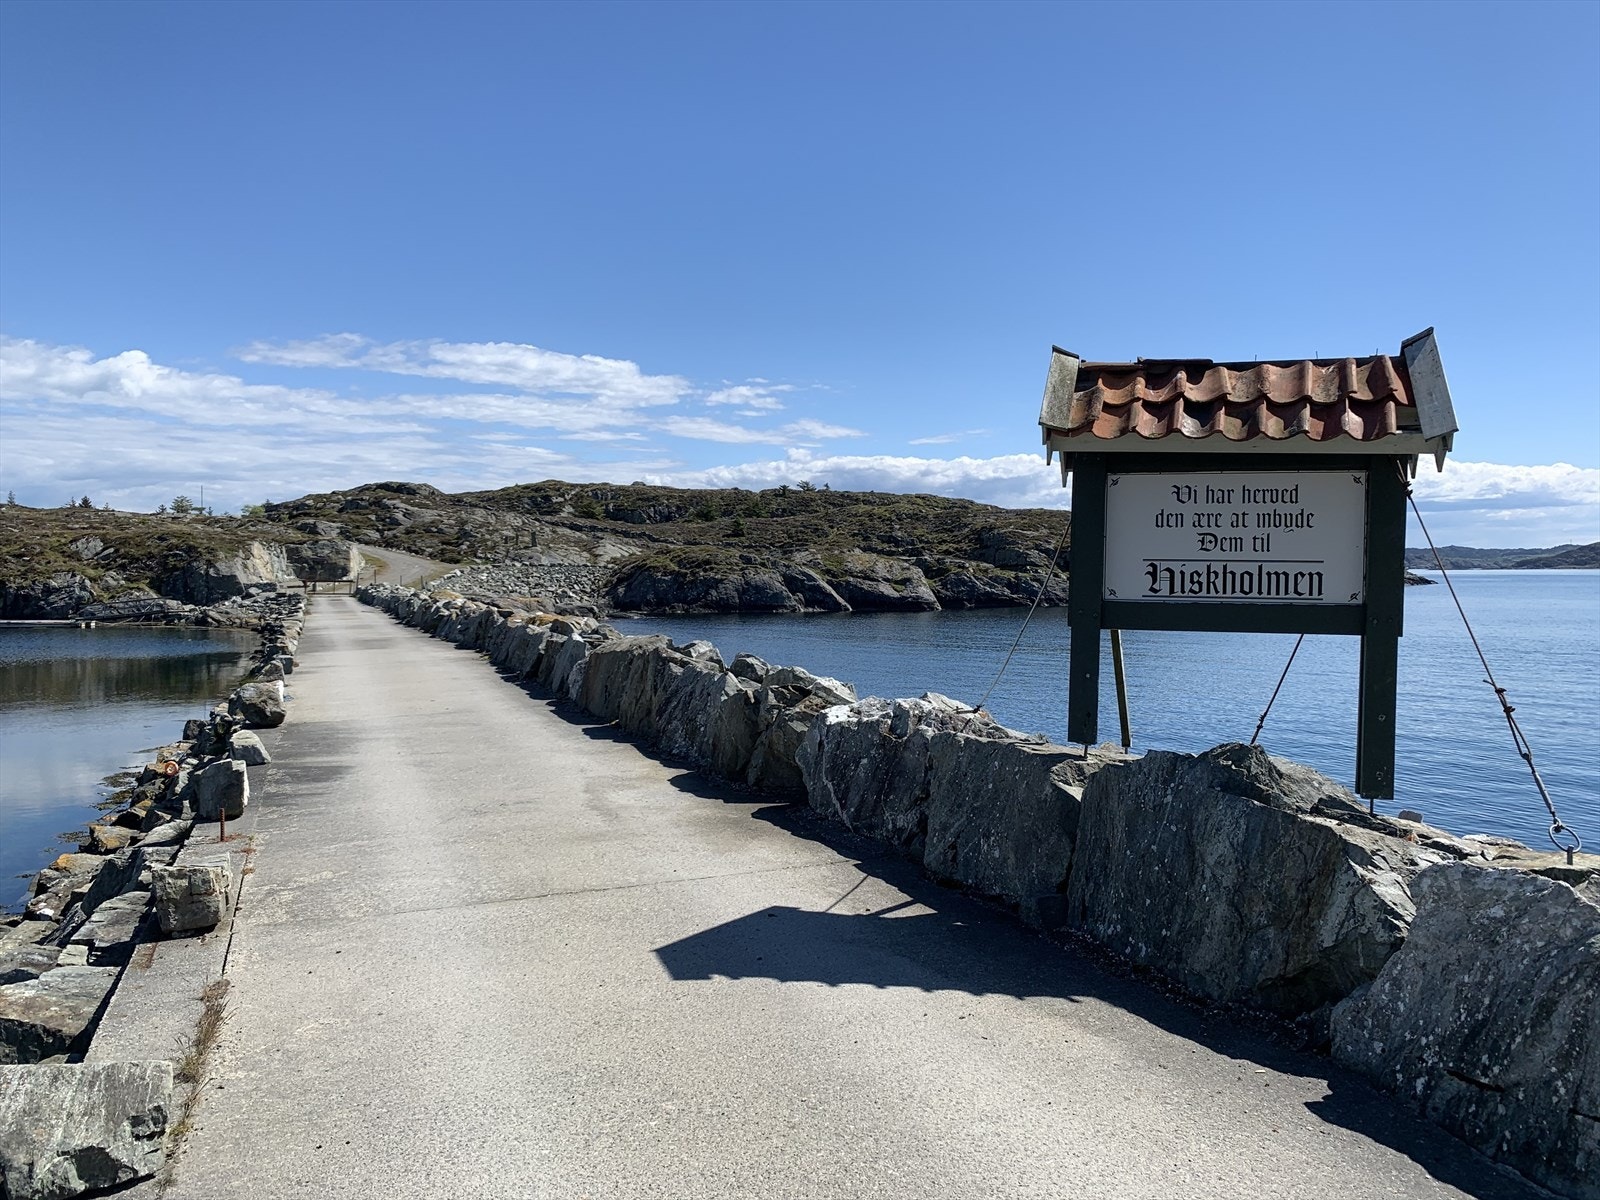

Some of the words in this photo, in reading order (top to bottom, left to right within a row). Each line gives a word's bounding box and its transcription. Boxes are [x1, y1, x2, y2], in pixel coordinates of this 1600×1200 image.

[1171, 484, 1198, 504] Vi
[1206, 484, 1235, 504] har
[1242, 484, 1300, 504] herved
[1155, 508, 1184, 528] den
[1192, 511, 1223, 528] ære
[1230, 511, 1249, 528] at
[1256, 508, 1315, 533] inbyde
[1196, 532, 1244, 552] Dem
[1252, 533, 1271, 552] til
[1144, 562, 1325, 597] Hiskholmen
